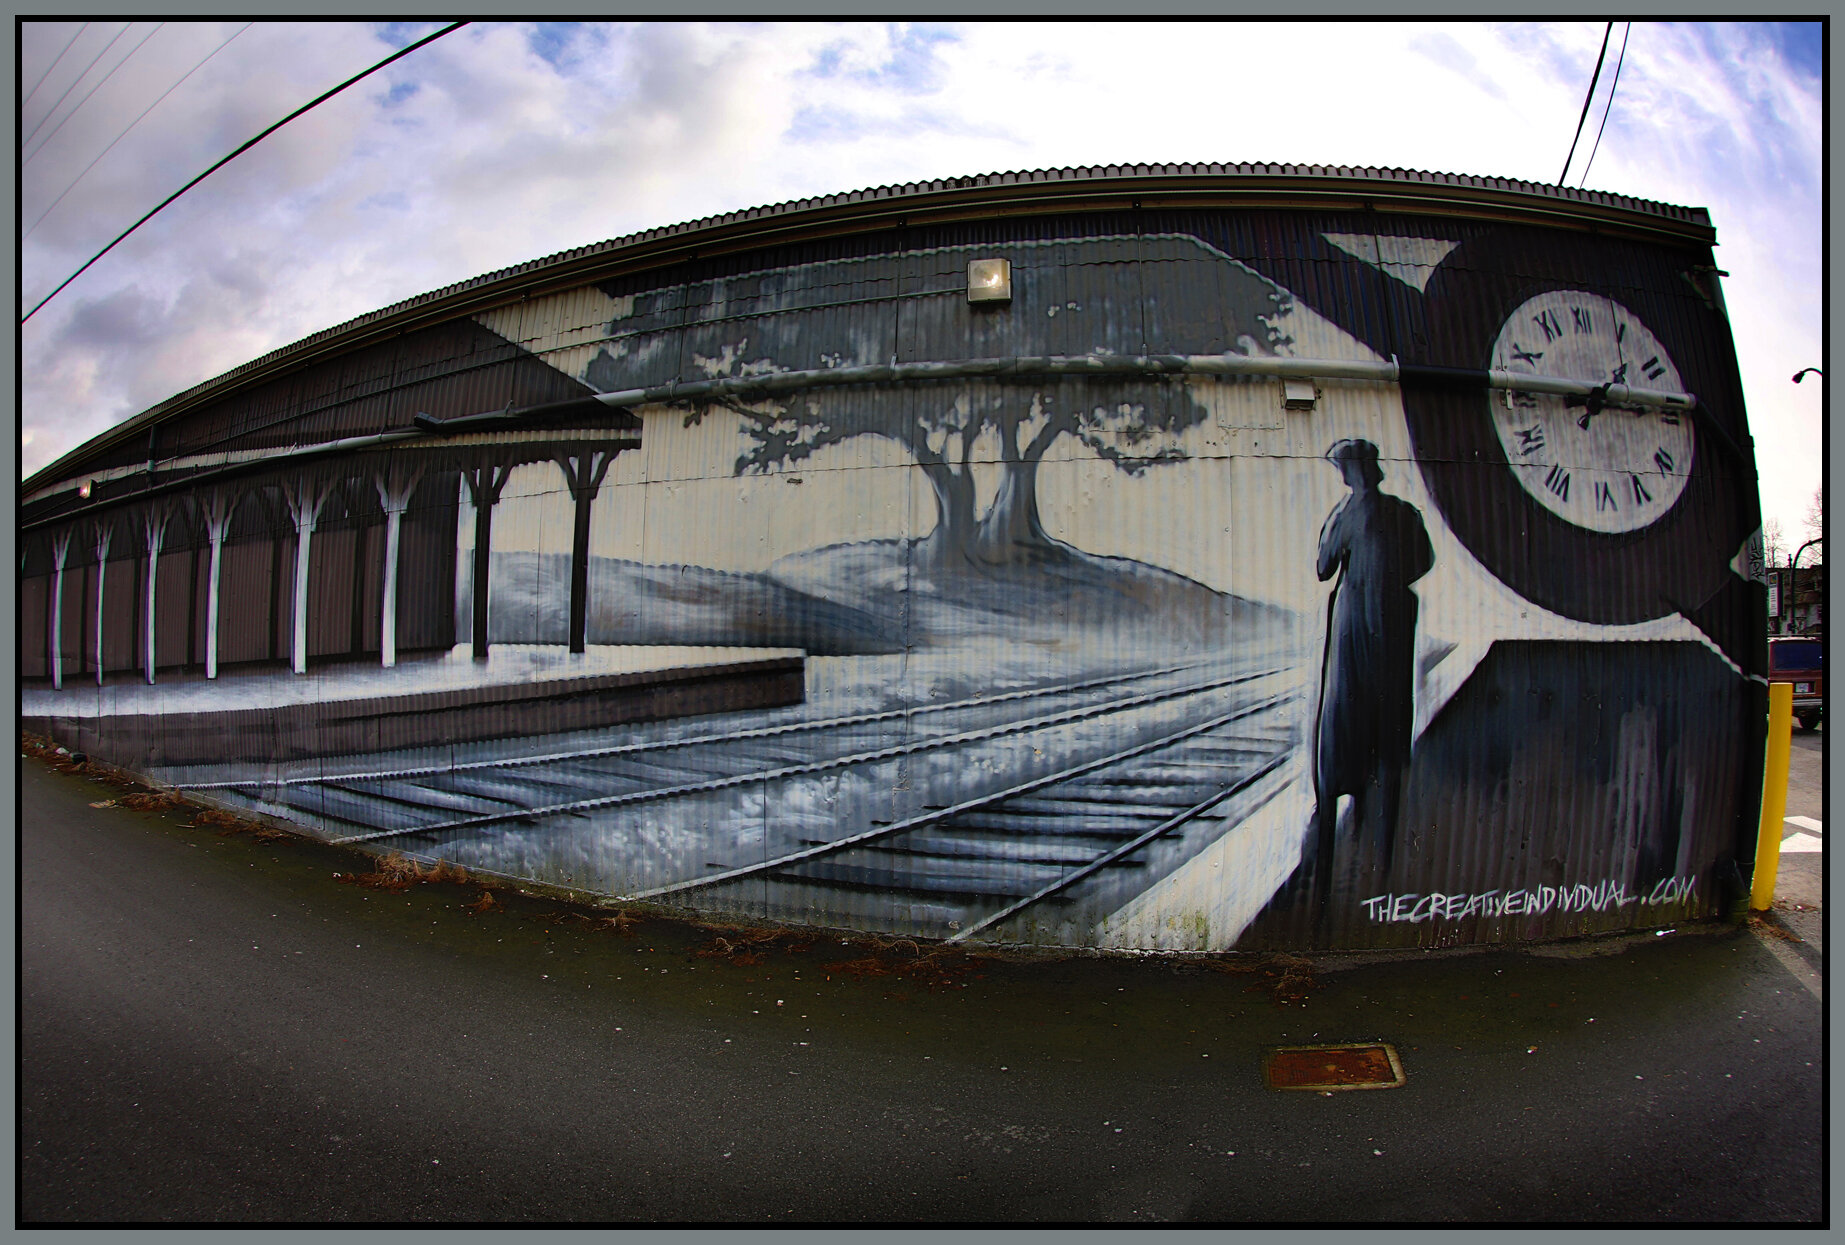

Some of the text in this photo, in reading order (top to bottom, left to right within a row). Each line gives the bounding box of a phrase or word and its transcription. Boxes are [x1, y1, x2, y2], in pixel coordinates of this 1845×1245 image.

[1533, 309, 1562, 343] XI
[1571, 307, 1592, 334] XII
[1511, 343, 1544, 368] X
[1641, 356, 1666, 380] II
[1595, 482, 1618, 512] VI
